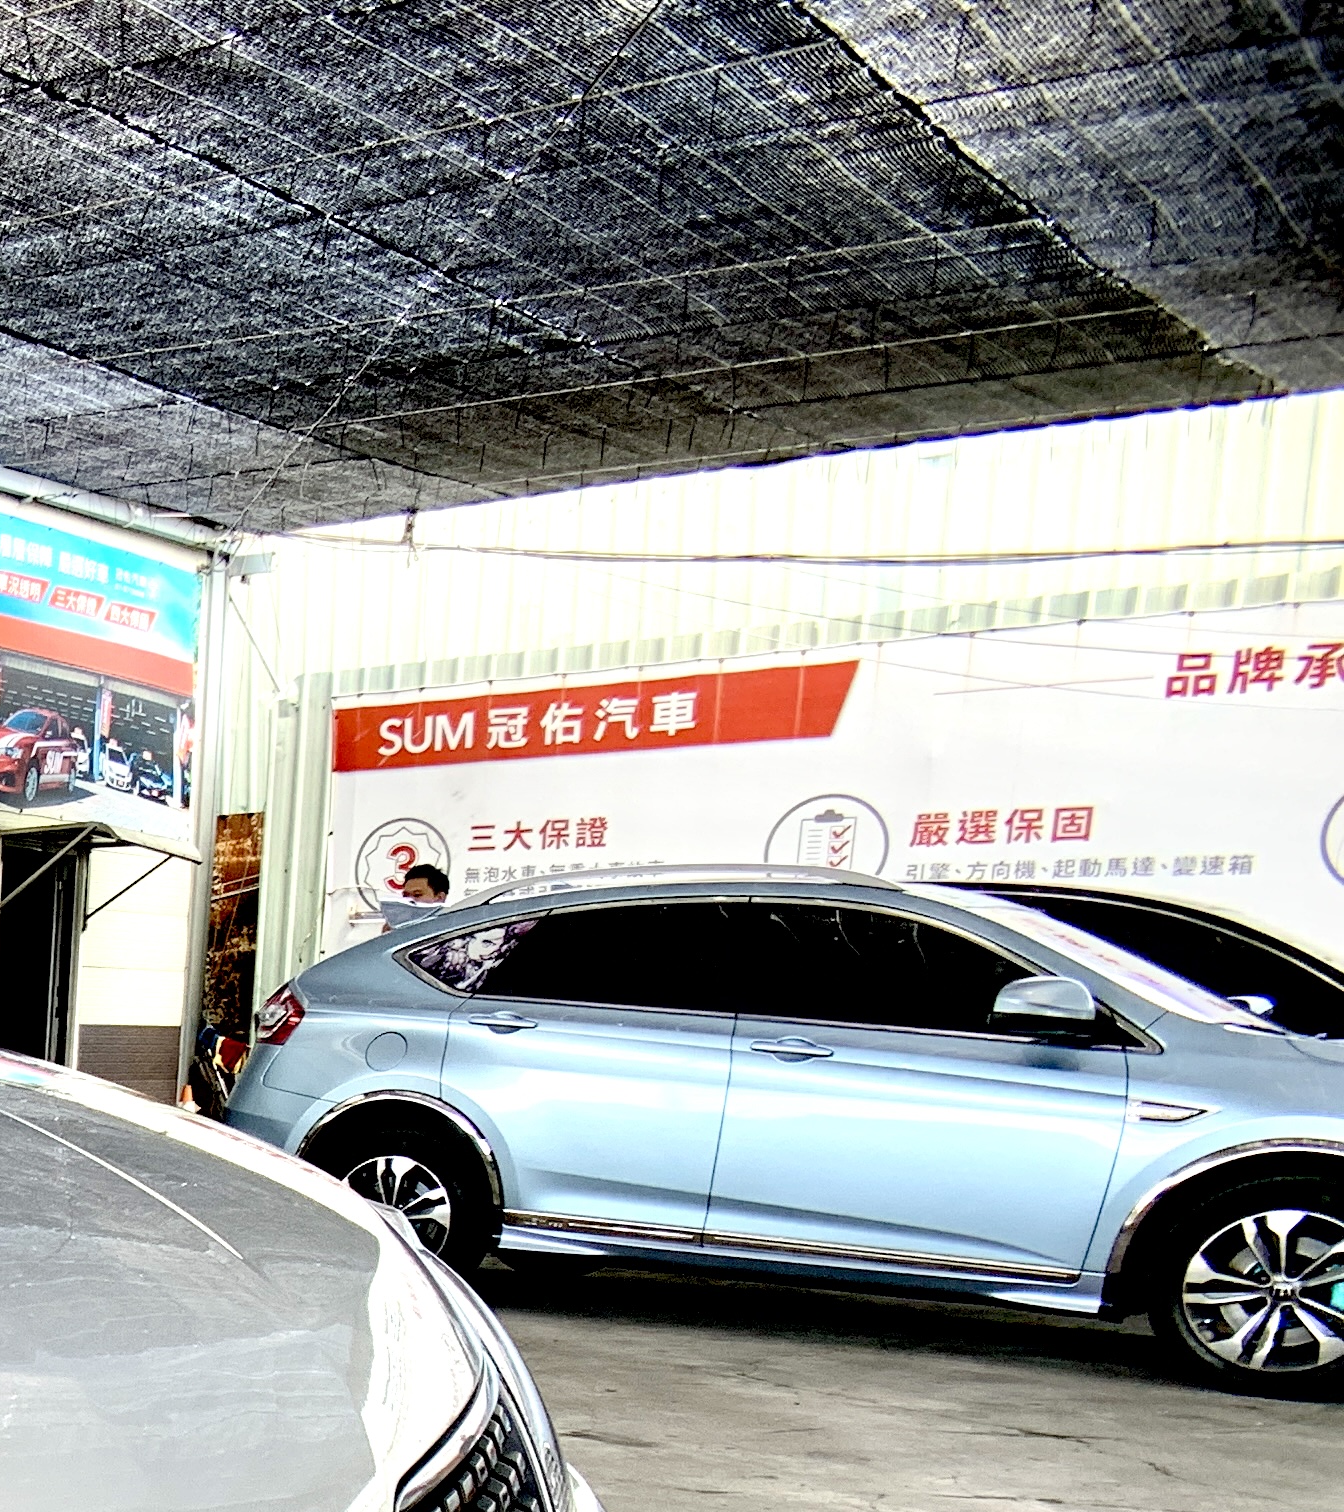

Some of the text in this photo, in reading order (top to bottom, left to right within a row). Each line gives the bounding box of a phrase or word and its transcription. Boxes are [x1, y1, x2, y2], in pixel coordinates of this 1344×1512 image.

[378, 690, 699, 757] SUM 冠佑汽車
[467, 816, 610, 852] 三大保證
[909, 805, 1097, 848] 嚴選保固
[385, 843, 419, 892] 3
[905, 854, 1257, 882] 引擎、方向機、起動馬達、變速箱
